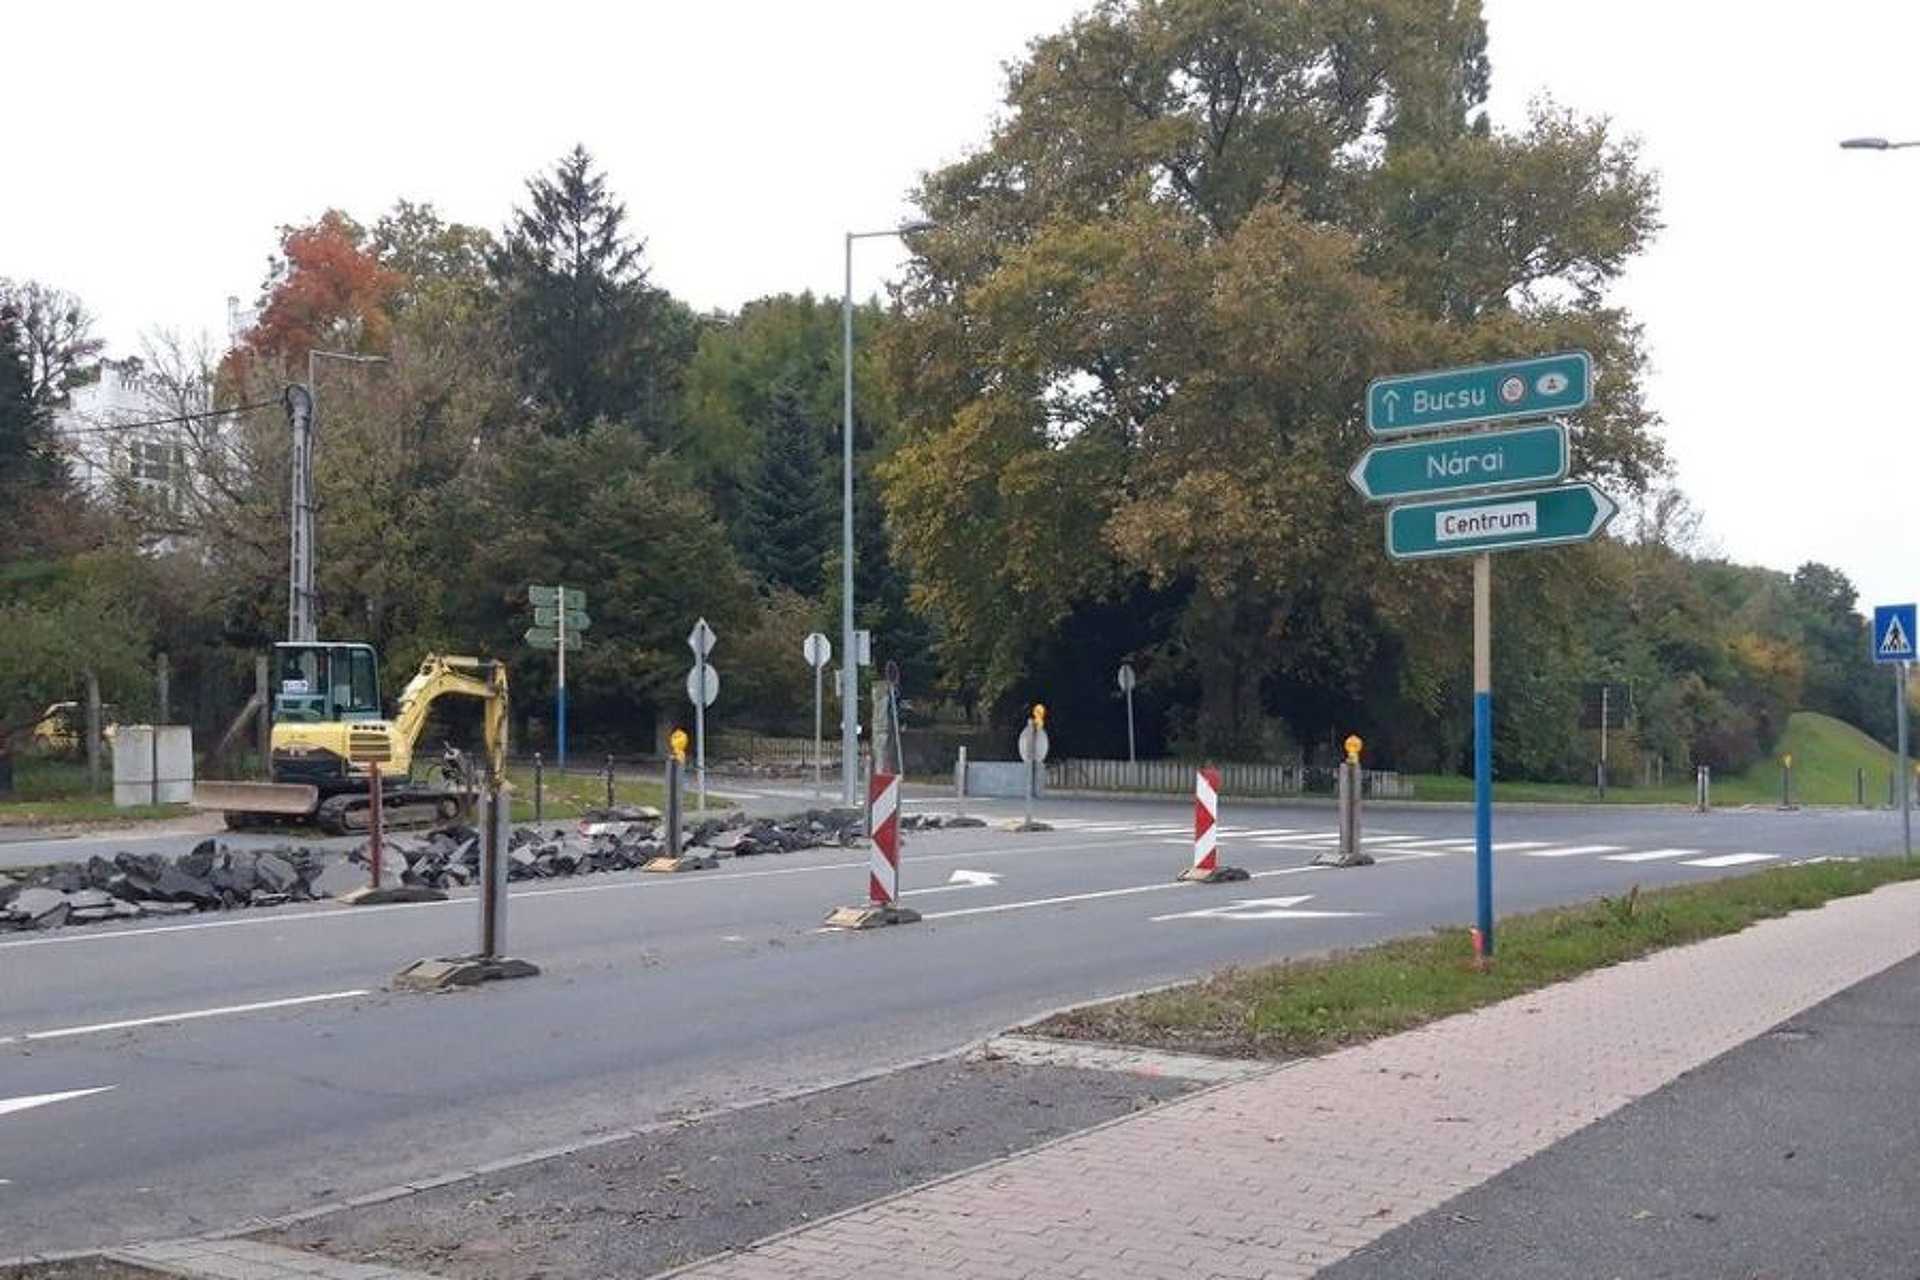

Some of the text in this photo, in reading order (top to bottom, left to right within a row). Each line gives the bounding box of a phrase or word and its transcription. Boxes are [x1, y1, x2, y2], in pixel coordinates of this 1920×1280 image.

[1413, 388, 1486, 413] Bucsu
[1426, 448, 1503, 478] Nárai
[1444, 511, 1530, 535] Centrum
